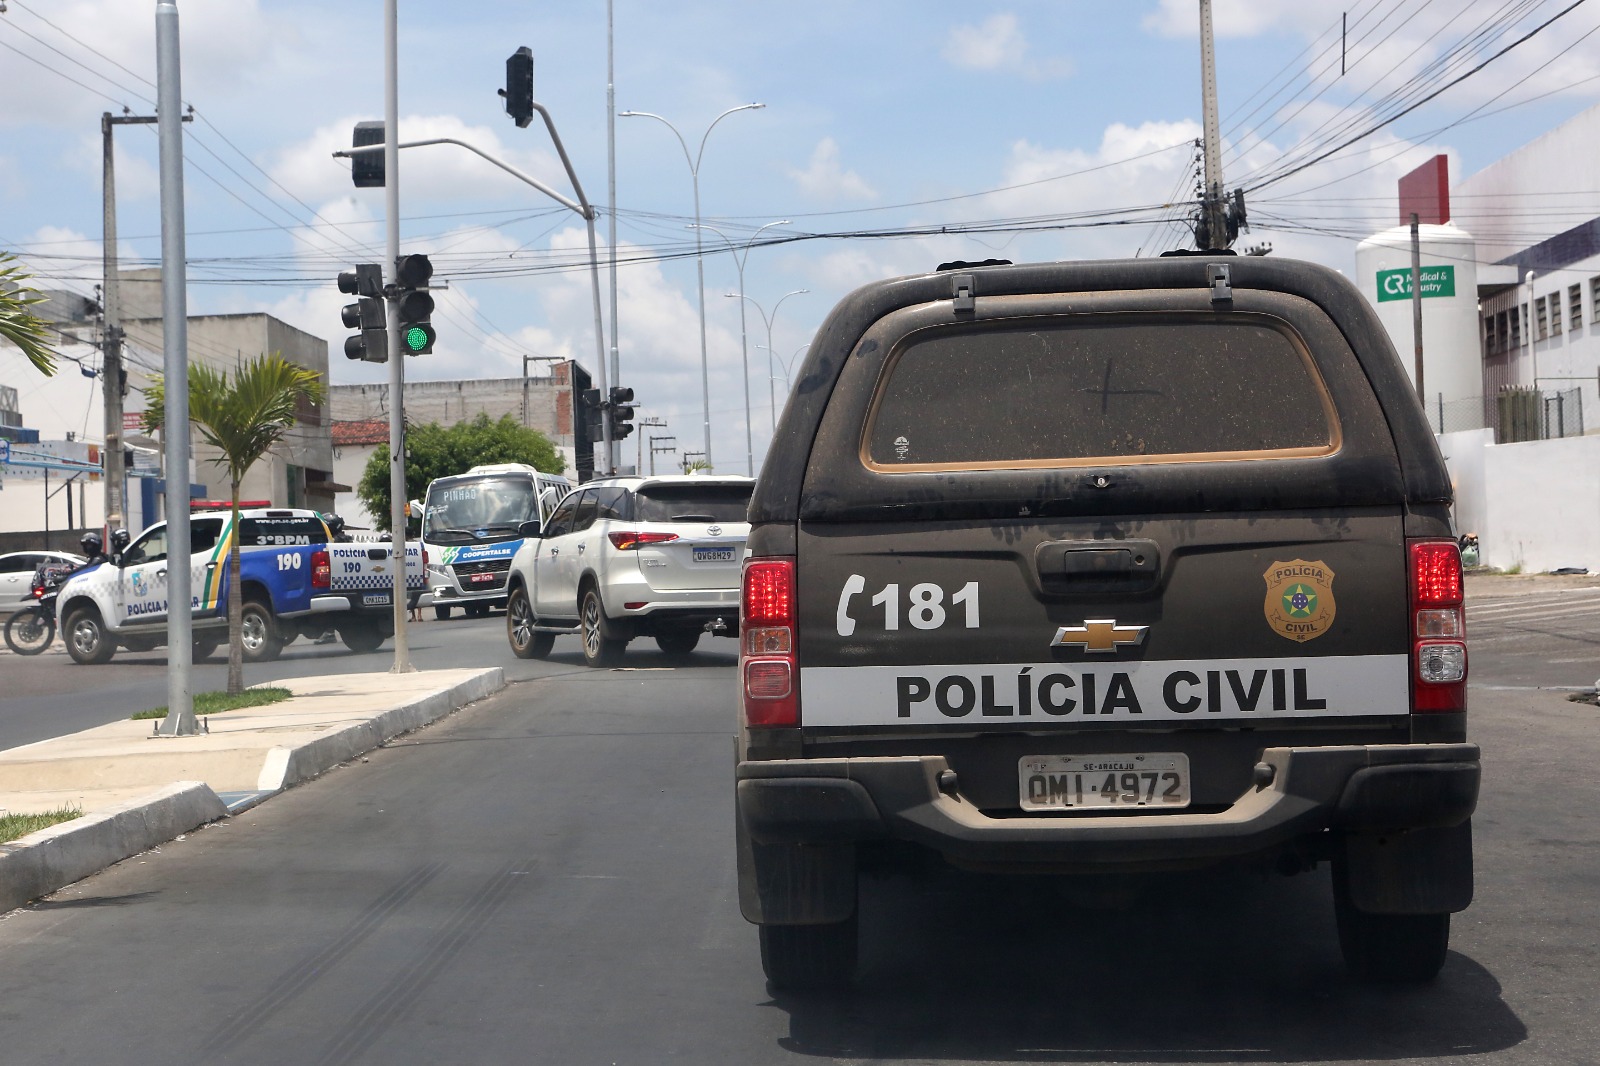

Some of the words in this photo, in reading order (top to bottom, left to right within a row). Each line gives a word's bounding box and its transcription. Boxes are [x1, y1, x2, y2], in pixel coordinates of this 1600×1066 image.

[1406, 272, 1439, 282] Mdical
[1441, 272, 1447, 280] &
[1384, 274, 1405, 294] CR
[1407, 283, 1441, 293] Inustry
[333, 548, 366, 558] POLÍCIA
[388, 548, 418, 557] MTAR
[462, 548, 511, 559] COOPERTALSE
[277, 552, 301, 571] 190
[343, 562, 361, 573] 190
[1276, 566, 1323, 579] POLÍCIA
[127, 600, 162, 616] POLÍCIA
[871, 581, 980, 631] 181
[1285, 623, 1318, 633] CIVIL
[896, 666, 1142, 718] POLÍCIA
[1162, 667, 1327, 714] CIVIL
